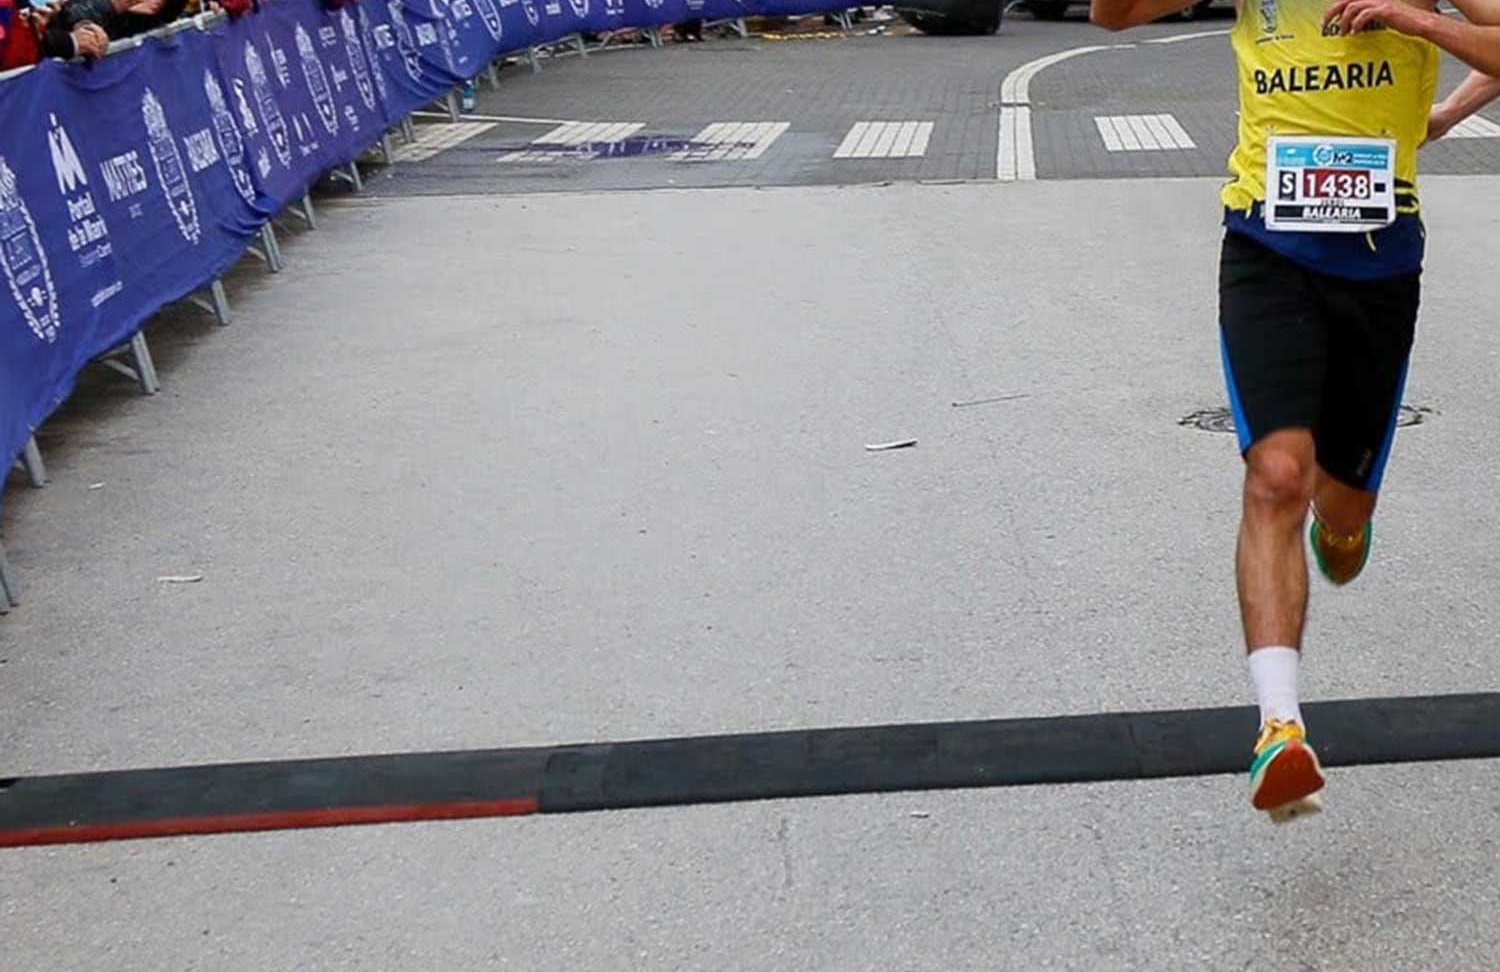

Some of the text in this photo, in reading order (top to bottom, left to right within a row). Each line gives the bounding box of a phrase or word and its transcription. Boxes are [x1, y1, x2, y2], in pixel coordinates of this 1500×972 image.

[1254, 60, 1394, 95] BALEARIA
[1282, 173, 1294, 195] S
[1306, 173, 1369, 198] 1438
[1302, 206, 1362, 220] BALEARIA
